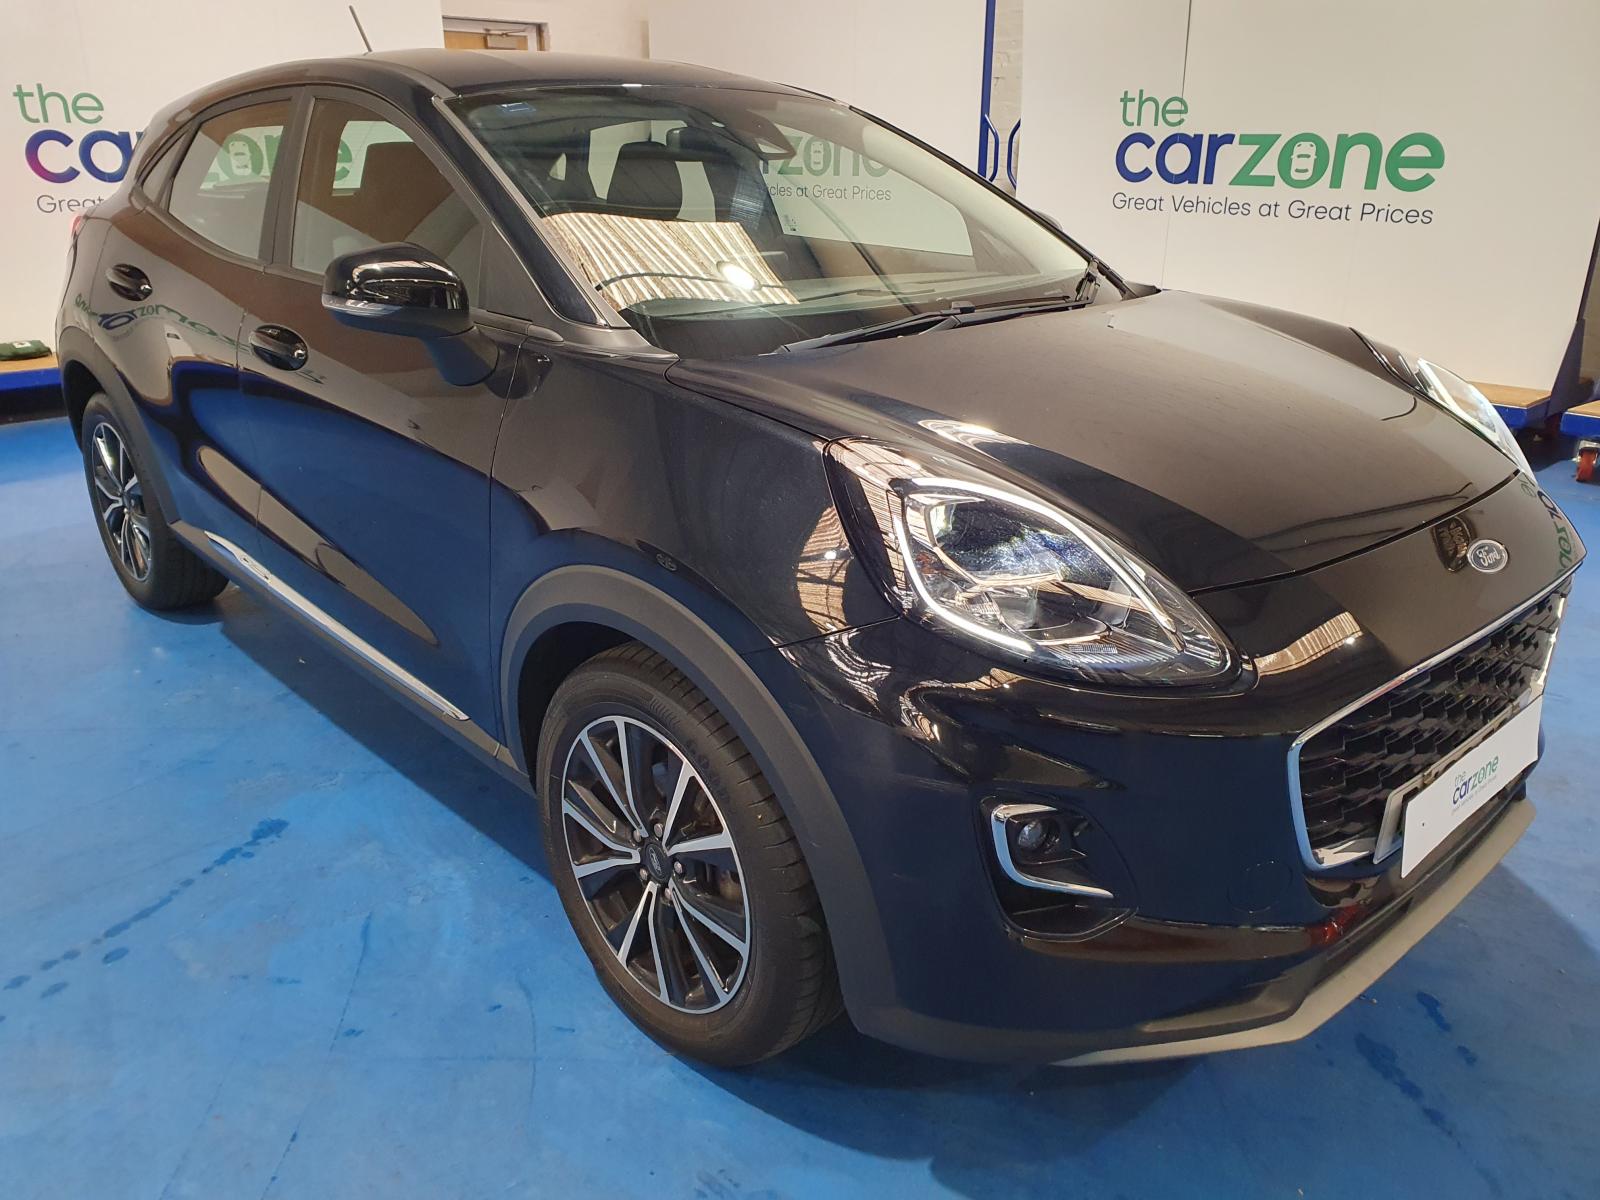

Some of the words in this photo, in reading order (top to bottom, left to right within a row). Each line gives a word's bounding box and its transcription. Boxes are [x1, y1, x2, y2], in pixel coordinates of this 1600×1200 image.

[13, 83, 105, 125] the
[1119, 89, 1188, 126] the
[25, 129, 144, 184] ca
[1115, 132, 1445, 192] carzone
[796, 187, 809, 198] at
[812, 184, 848, 200] Great
[852, 186, 892, 201] Prices
[1112, 192, 1164, 212] Great
[1171, 195, 1251, 217] Vehicles
[1258, 201, 1280, 219] at
[1287, 200, 1352, 222] Great
[1360, 203, 1434, 225] Prices
[1476, 545, 1502, 567] Ford
[1452, 755, 1499, 804] carzone
